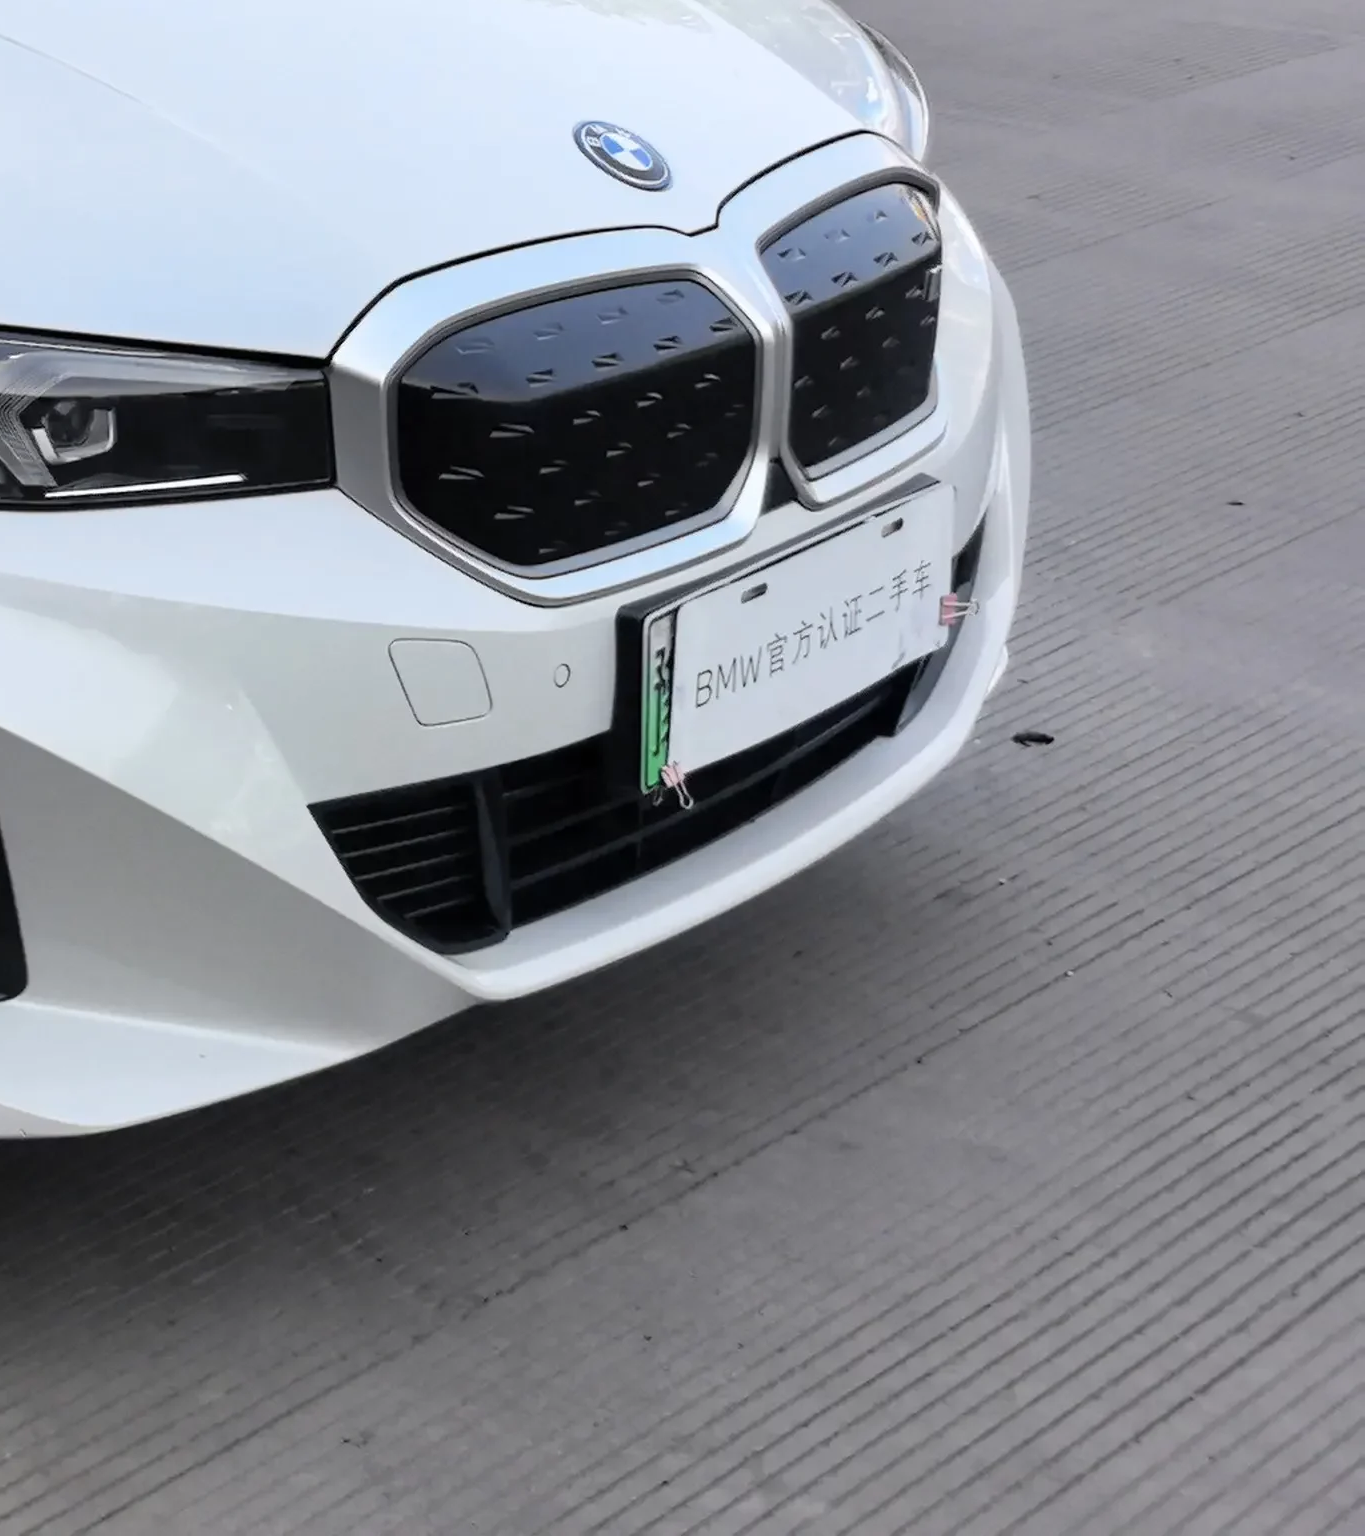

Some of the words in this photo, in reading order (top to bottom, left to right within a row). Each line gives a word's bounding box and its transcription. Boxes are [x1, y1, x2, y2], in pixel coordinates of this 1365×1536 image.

[695, 560, 932, 709] BMW官方认证二手车
